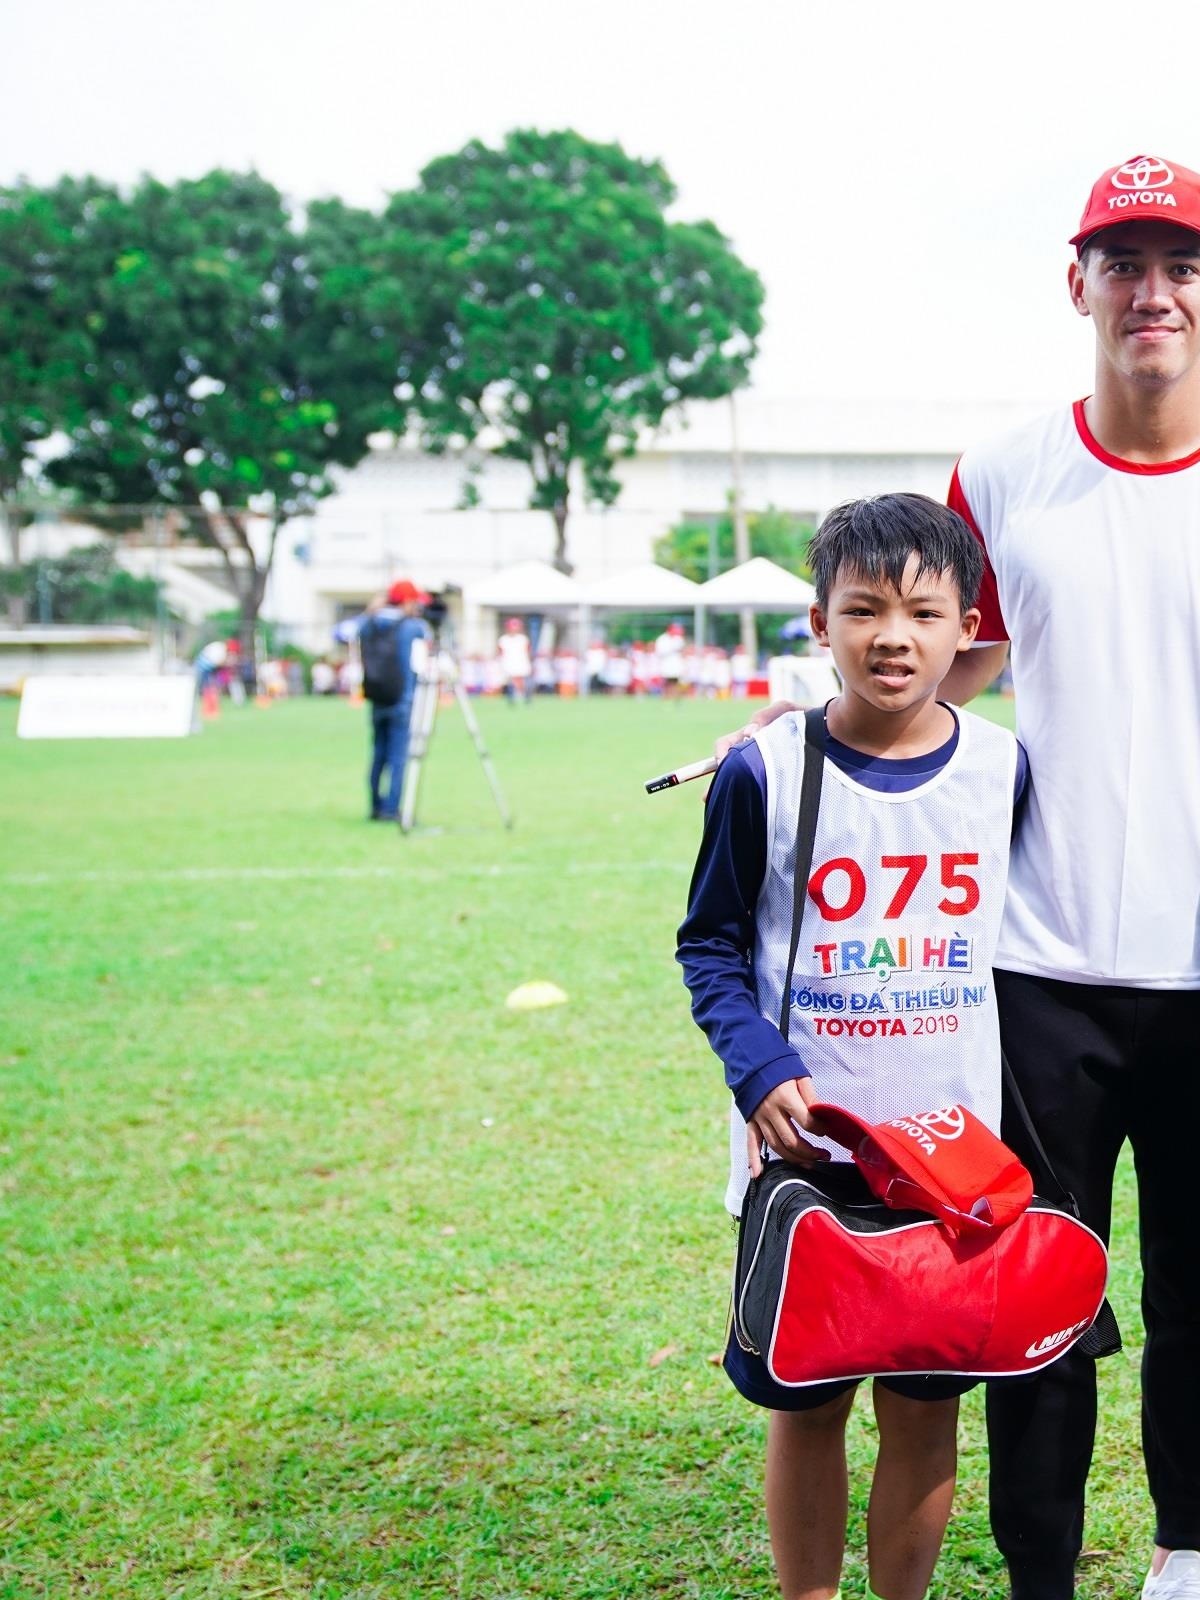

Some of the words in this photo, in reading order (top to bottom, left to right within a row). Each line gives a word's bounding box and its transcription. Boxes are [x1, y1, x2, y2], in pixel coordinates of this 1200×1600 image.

[1107, 191, 1177, 209] TOYOTA
[807, 853, 980, 922] 075
[814, 937, 907, 977] TRẠI
[923, 931, 969, 968] HÈ
[849, 985, 886, 1010] ĐÁ
[890, 982, 957, 1009] THIẾU
[814, 1017, 907, 1037] TOYOTA
[912, 1015, 958, 1034] 2019
[1038, 1317, 1089, 1350] NIKE
